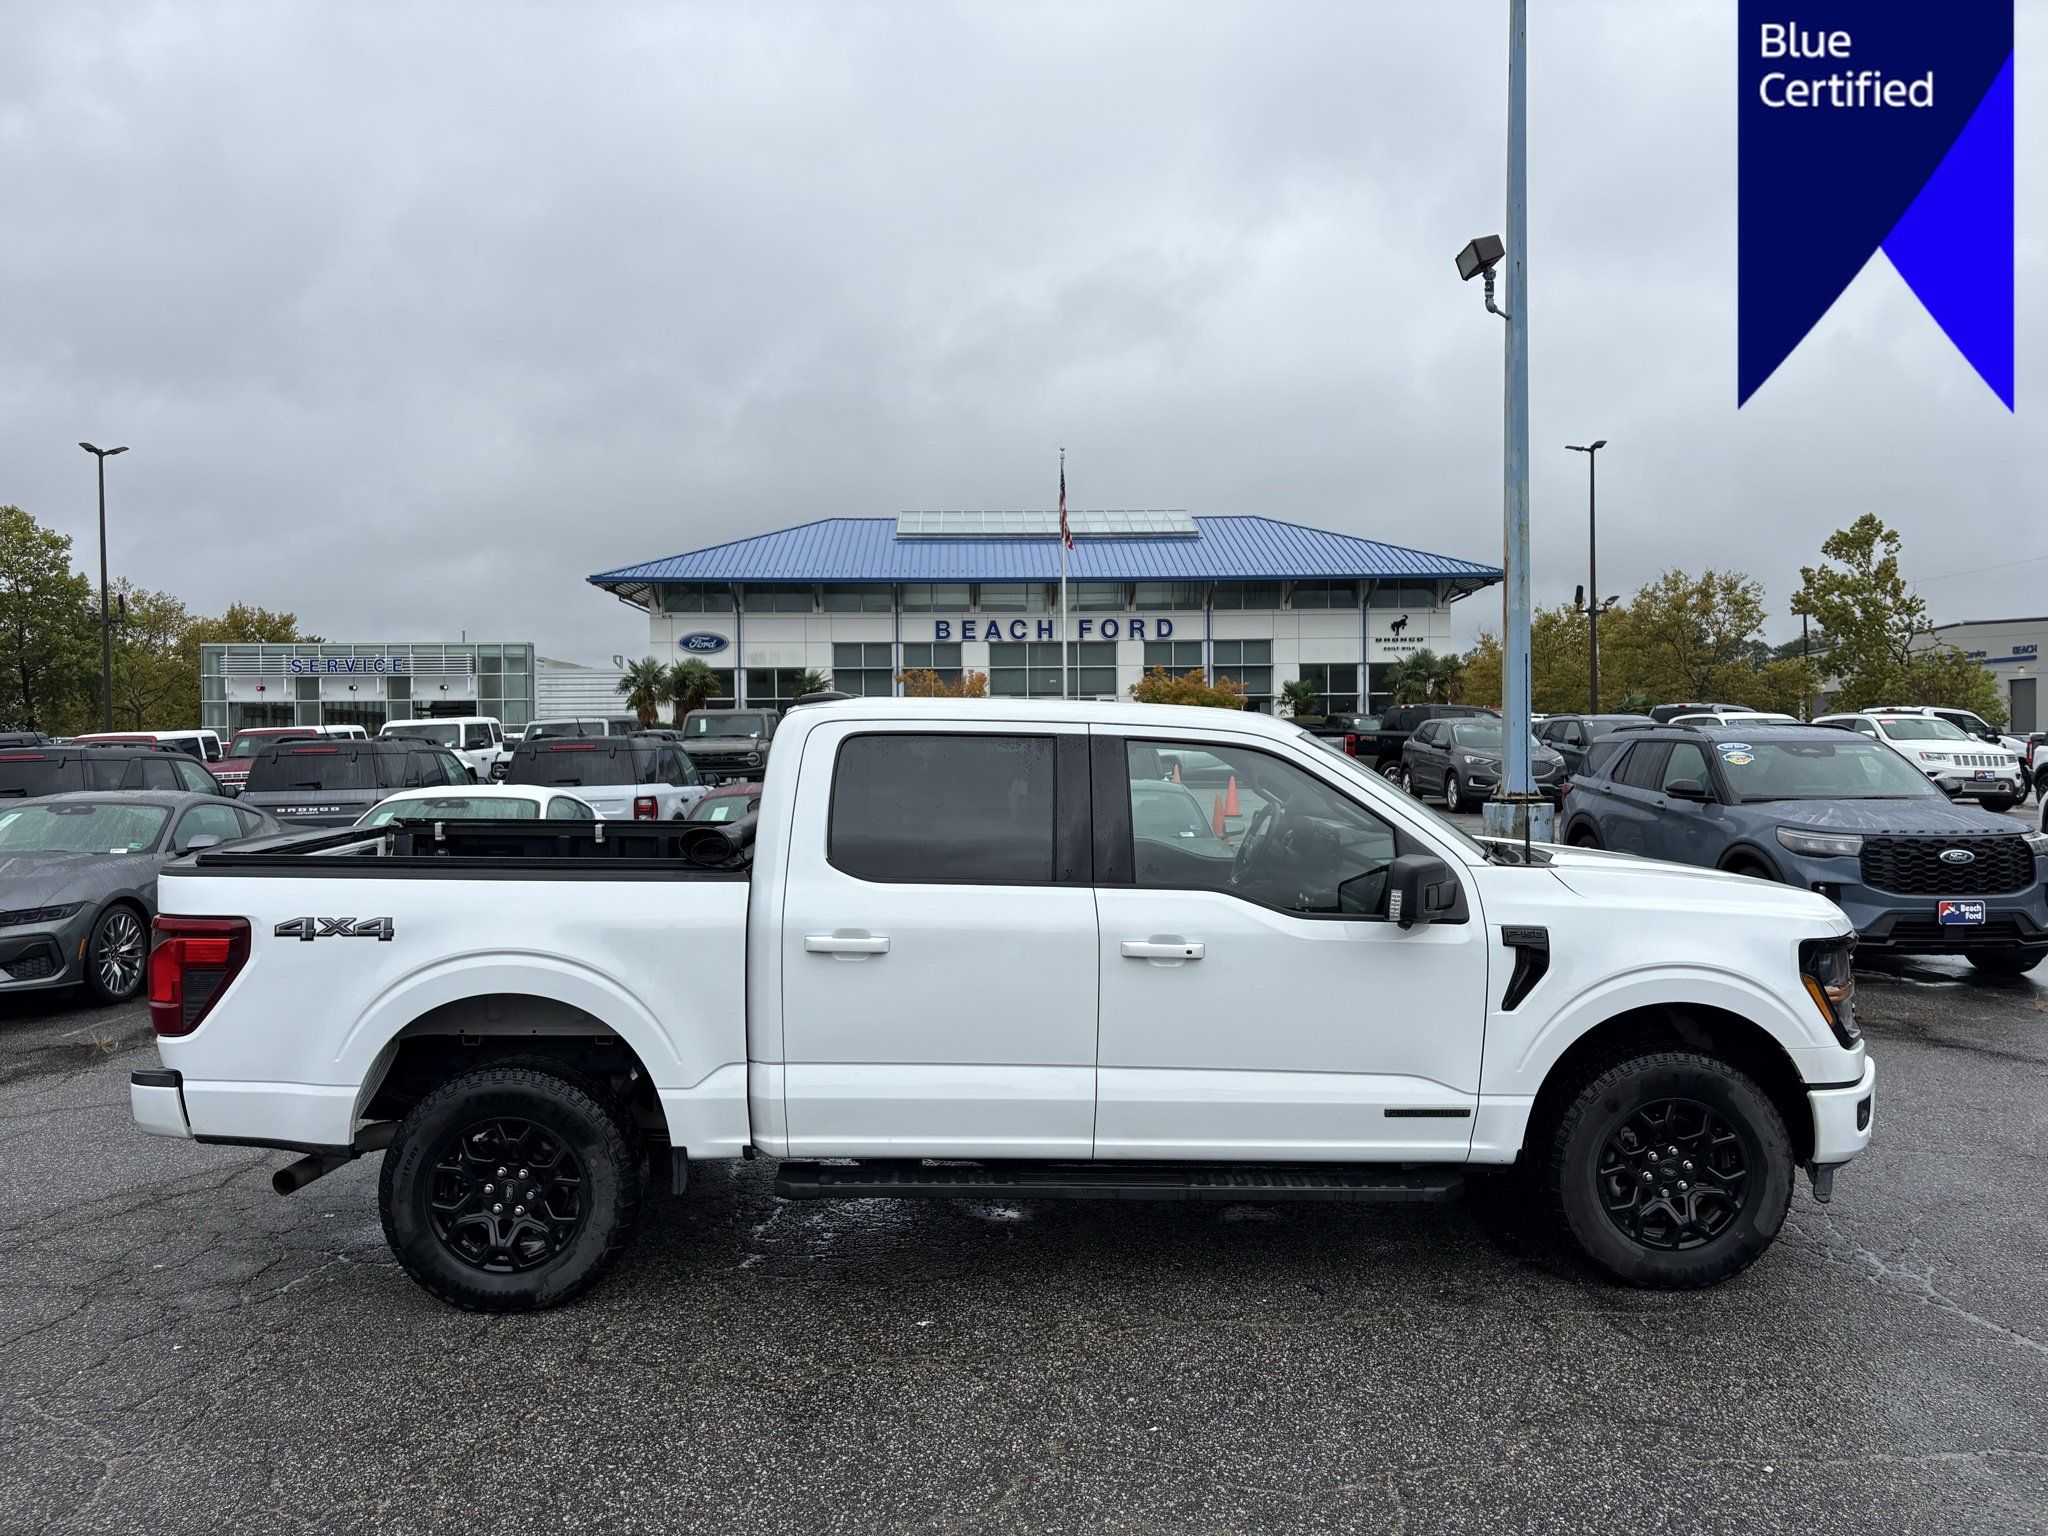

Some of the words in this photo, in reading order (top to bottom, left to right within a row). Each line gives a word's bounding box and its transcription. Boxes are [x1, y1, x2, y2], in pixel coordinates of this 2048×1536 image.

[935, 618, 1054, 640] BEACH
[1078, 618, 1174, 640] FORD
[688, 636, 717, 648] Ford
[2012, 644, 2038, 655] BEACH
[291, 659, 403, 673] SERVICE
[1948, 851, 1969, 861] Ford
[1960, 904, 1982, 912] Beach
[1965, 911, 1982, 920] Ford
